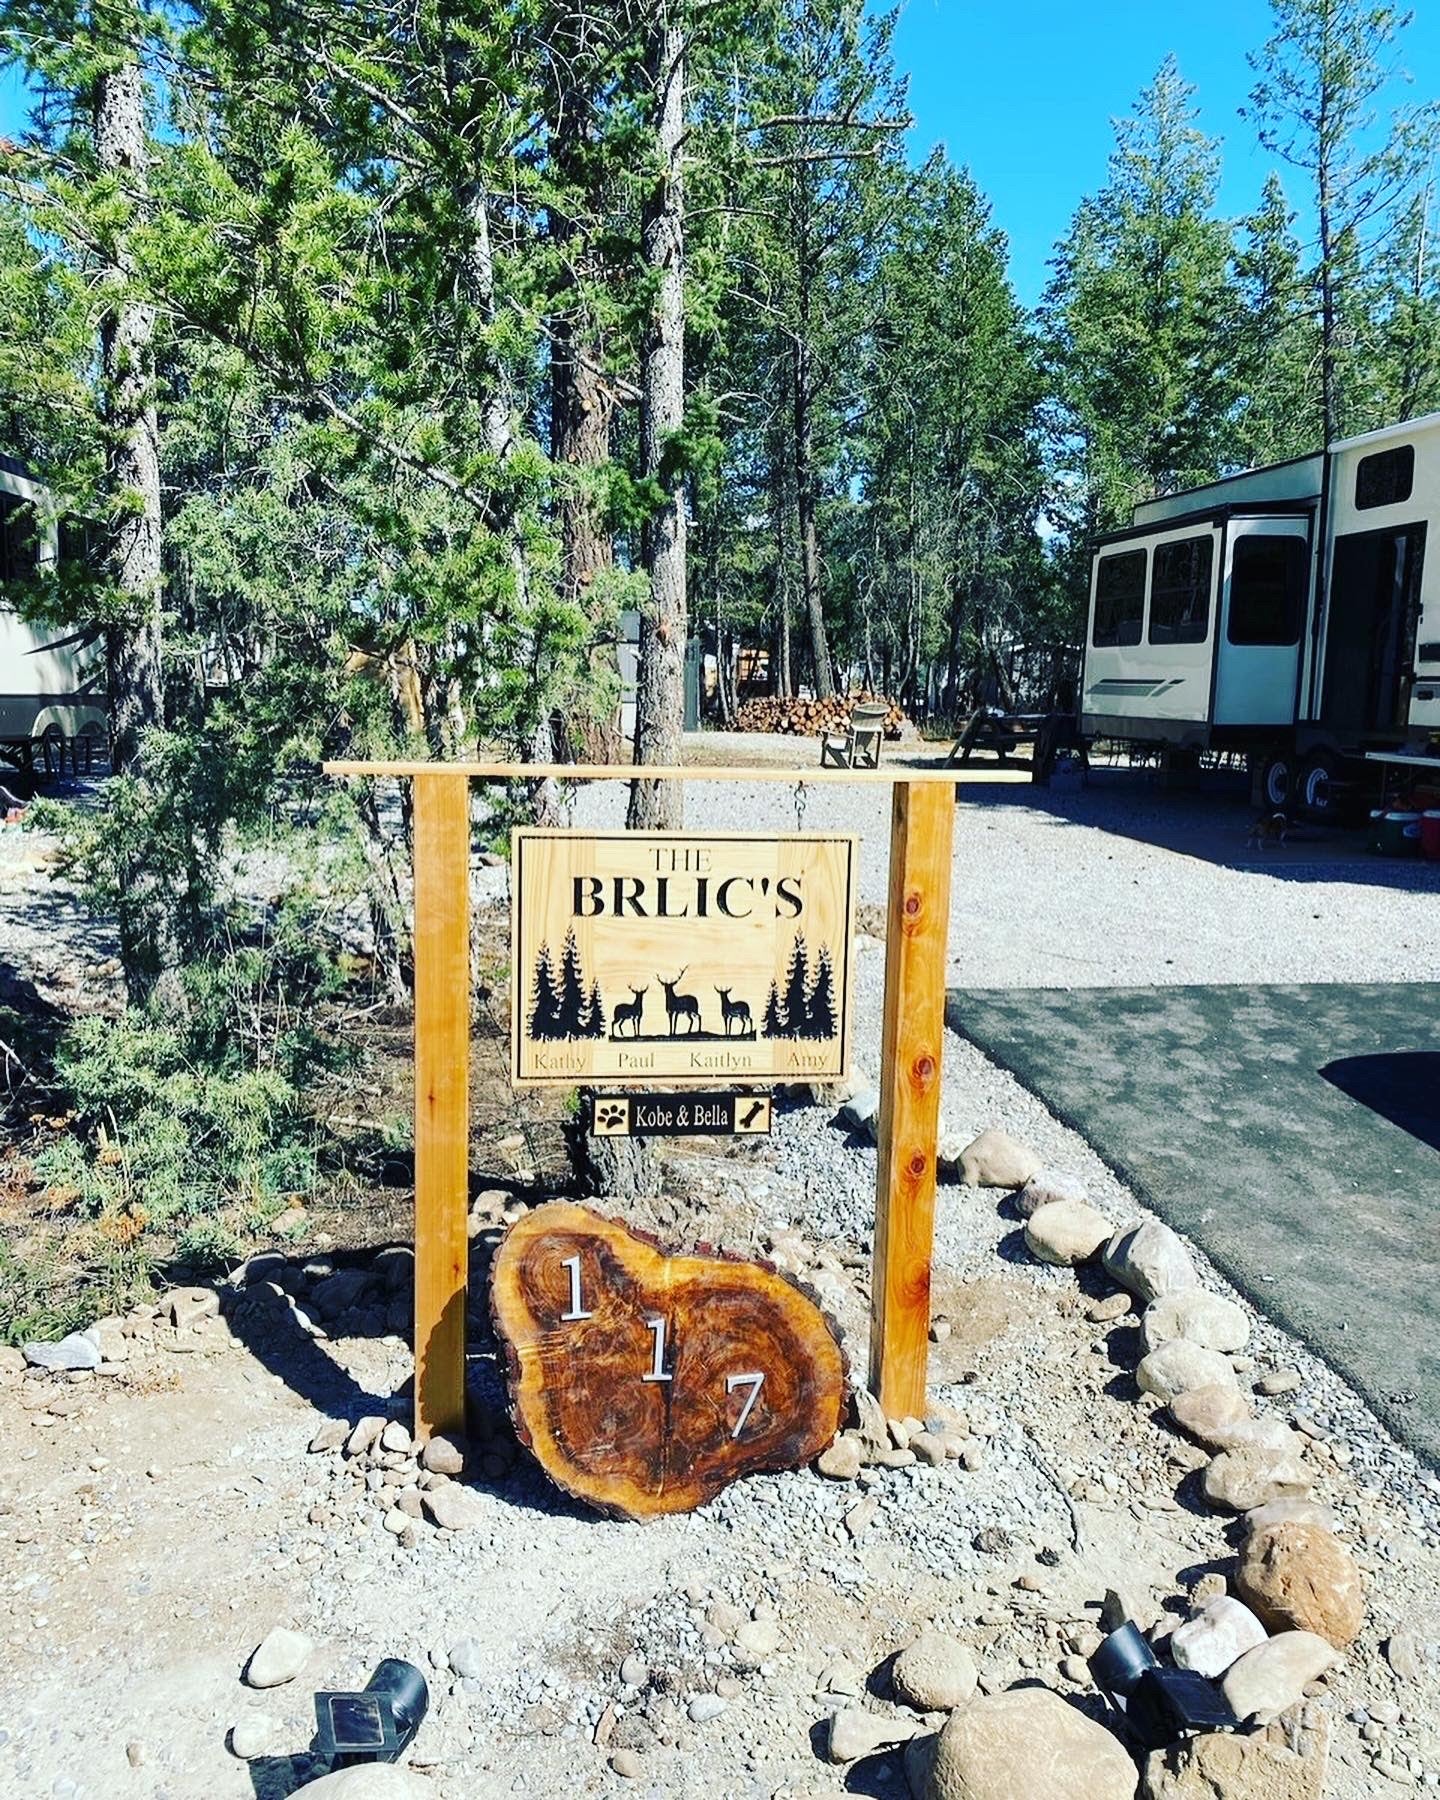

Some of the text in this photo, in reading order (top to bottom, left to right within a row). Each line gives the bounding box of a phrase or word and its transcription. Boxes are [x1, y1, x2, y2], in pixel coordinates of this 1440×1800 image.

[648, 848, 712, 872] THE
[571, 876, 804, 918] BRLIC'S
[533, 1051, 829, 1072] Kathy Paul Kaitlyn Amy
[635, 1104, 729, 1127] Kobe & Bella
